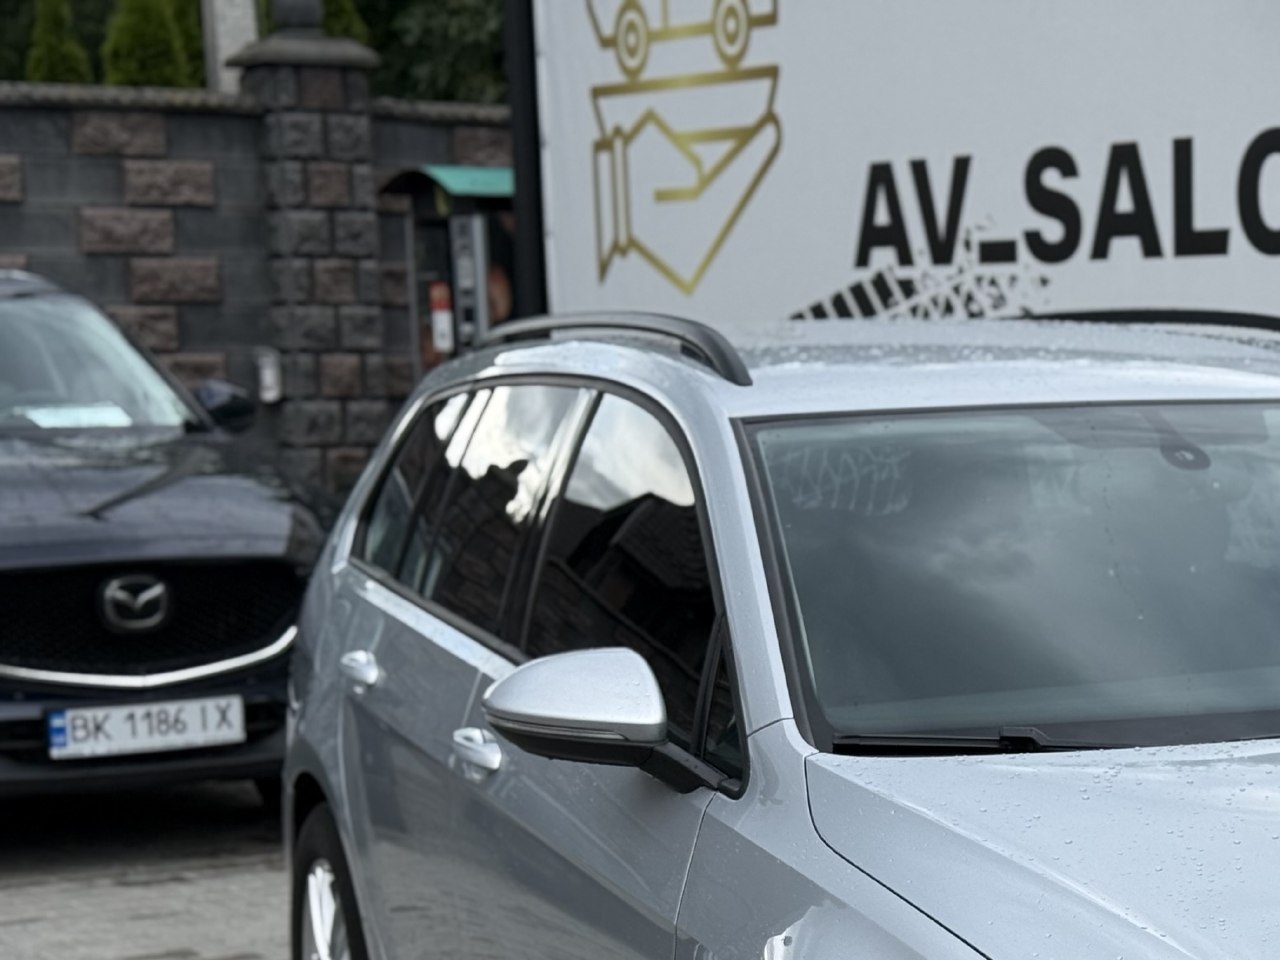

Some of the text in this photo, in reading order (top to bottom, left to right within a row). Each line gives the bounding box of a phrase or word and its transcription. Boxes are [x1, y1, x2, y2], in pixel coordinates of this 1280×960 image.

[70, 712, 113, 743] BK
[124, 705, 188, 740] 1186
[200, 701, 235, 733] IX
